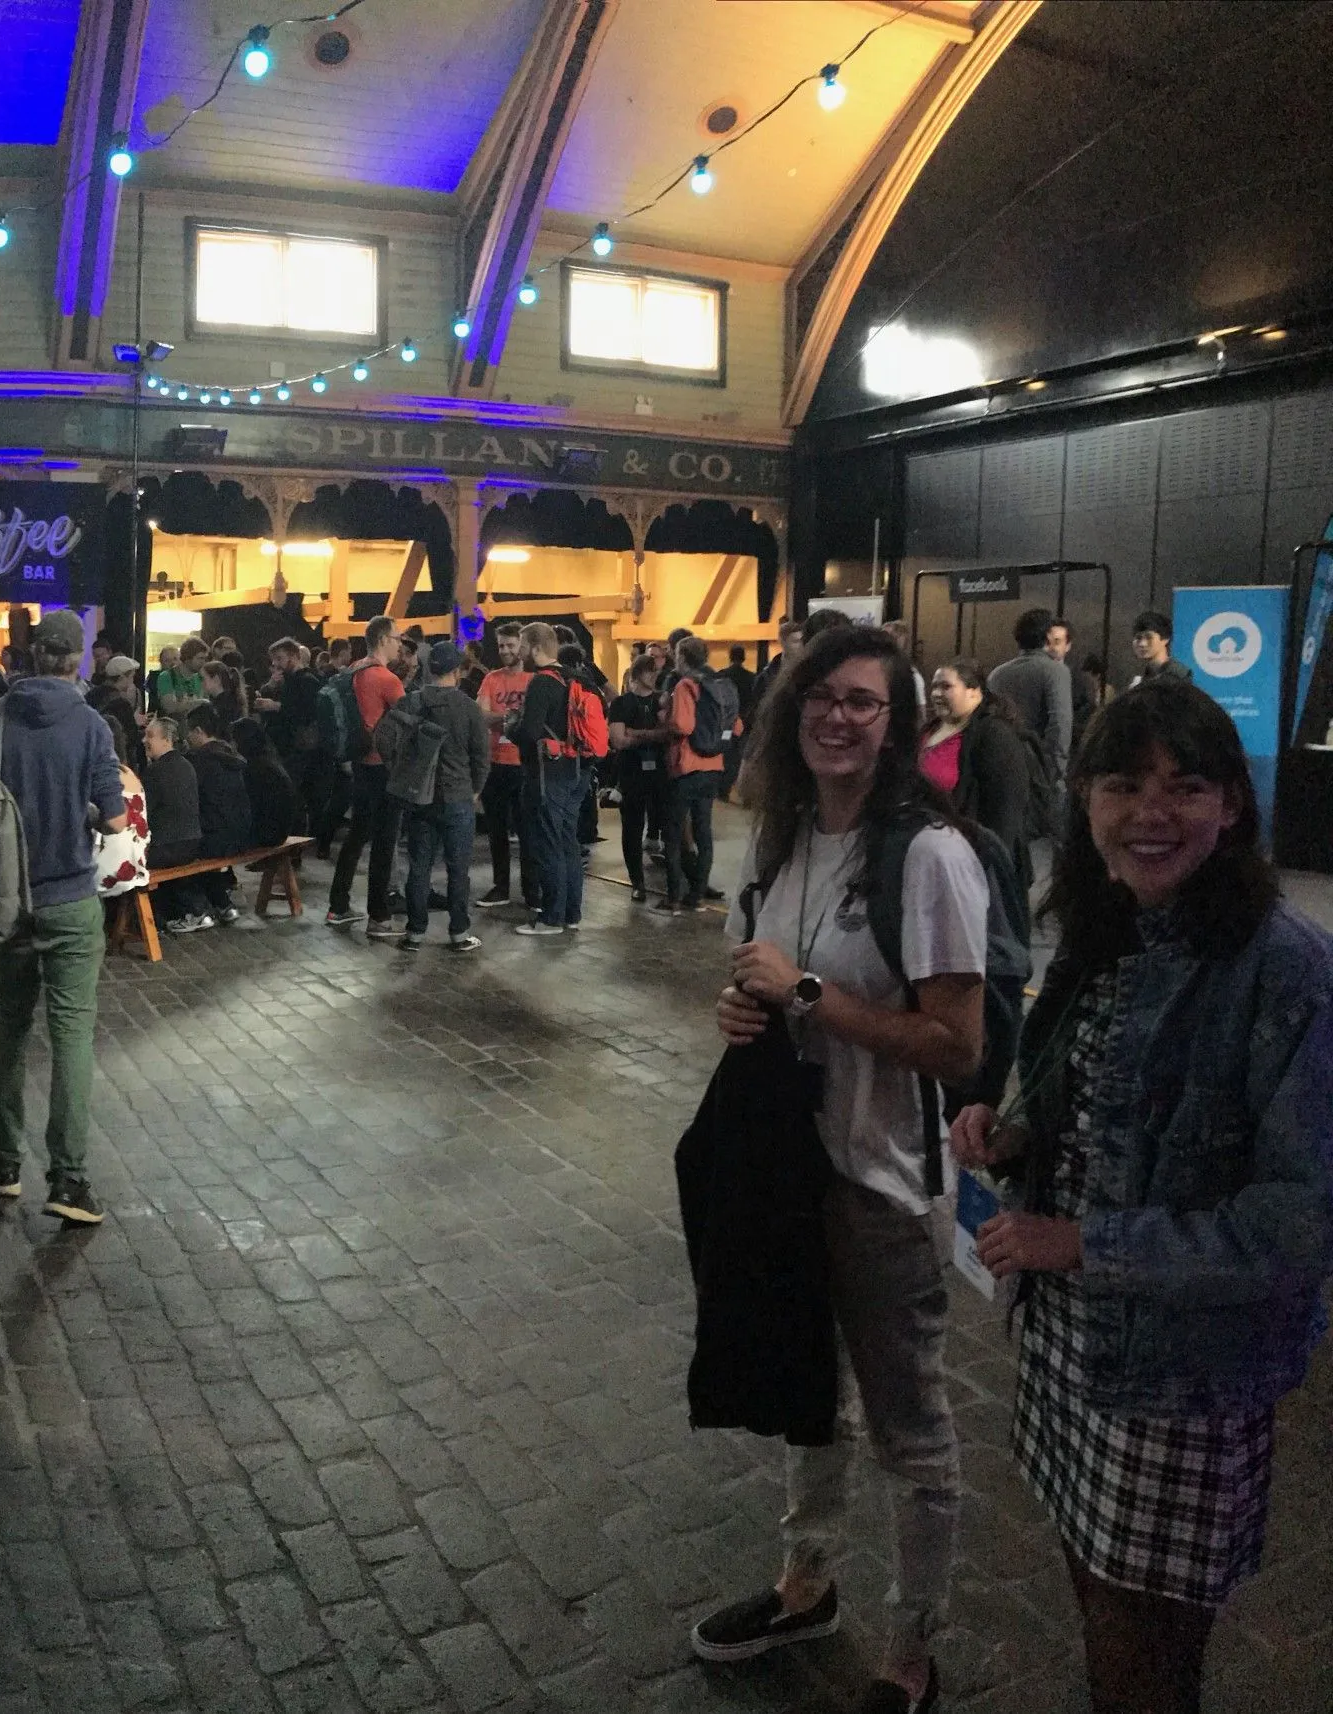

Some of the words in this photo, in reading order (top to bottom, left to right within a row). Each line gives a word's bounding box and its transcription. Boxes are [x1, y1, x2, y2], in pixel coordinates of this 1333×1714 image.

[622, 449, 650, 475] &
[668, 451, 742, 483] CO.
[23, 565, 56, 580] BAR
